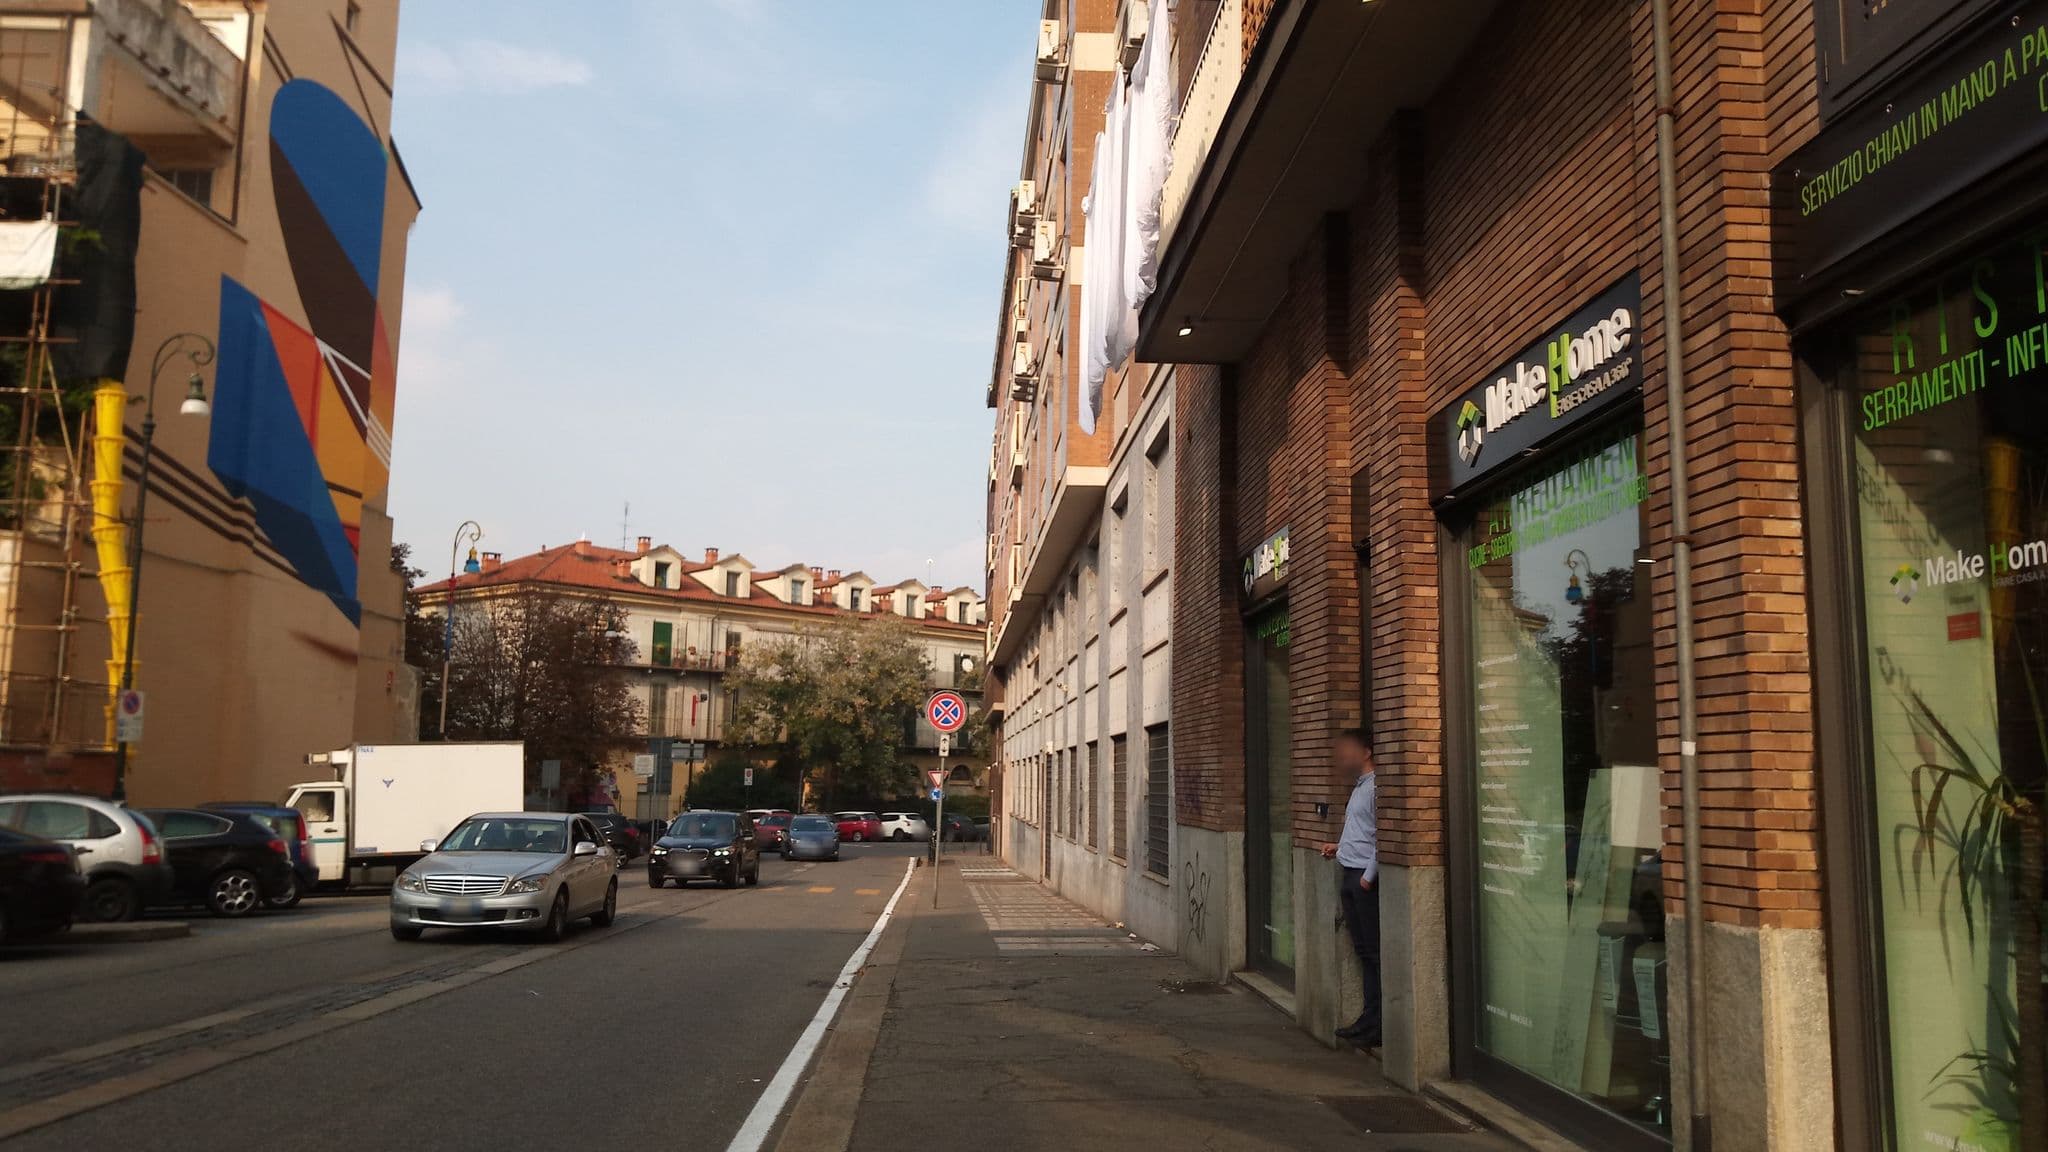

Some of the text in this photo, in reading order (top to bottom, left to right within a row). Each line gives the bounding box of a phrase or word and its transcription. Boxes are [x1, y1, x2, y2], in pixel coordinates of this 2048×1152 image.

[1801, 150, 1863, 217] SERVIZIO
[1865, 111, 1918, 175] CHIAVI
[1920, 97, 1938, 140] IN
[1941, 59, 1997, 127] MANO
[2003, 47, 2017, 88] A
[1485, 307, 1632, 433] Make Home
[1863, 348, 1986, 432] SERRAMENTI
[1926, 540, 2048, 587] Make Hom
